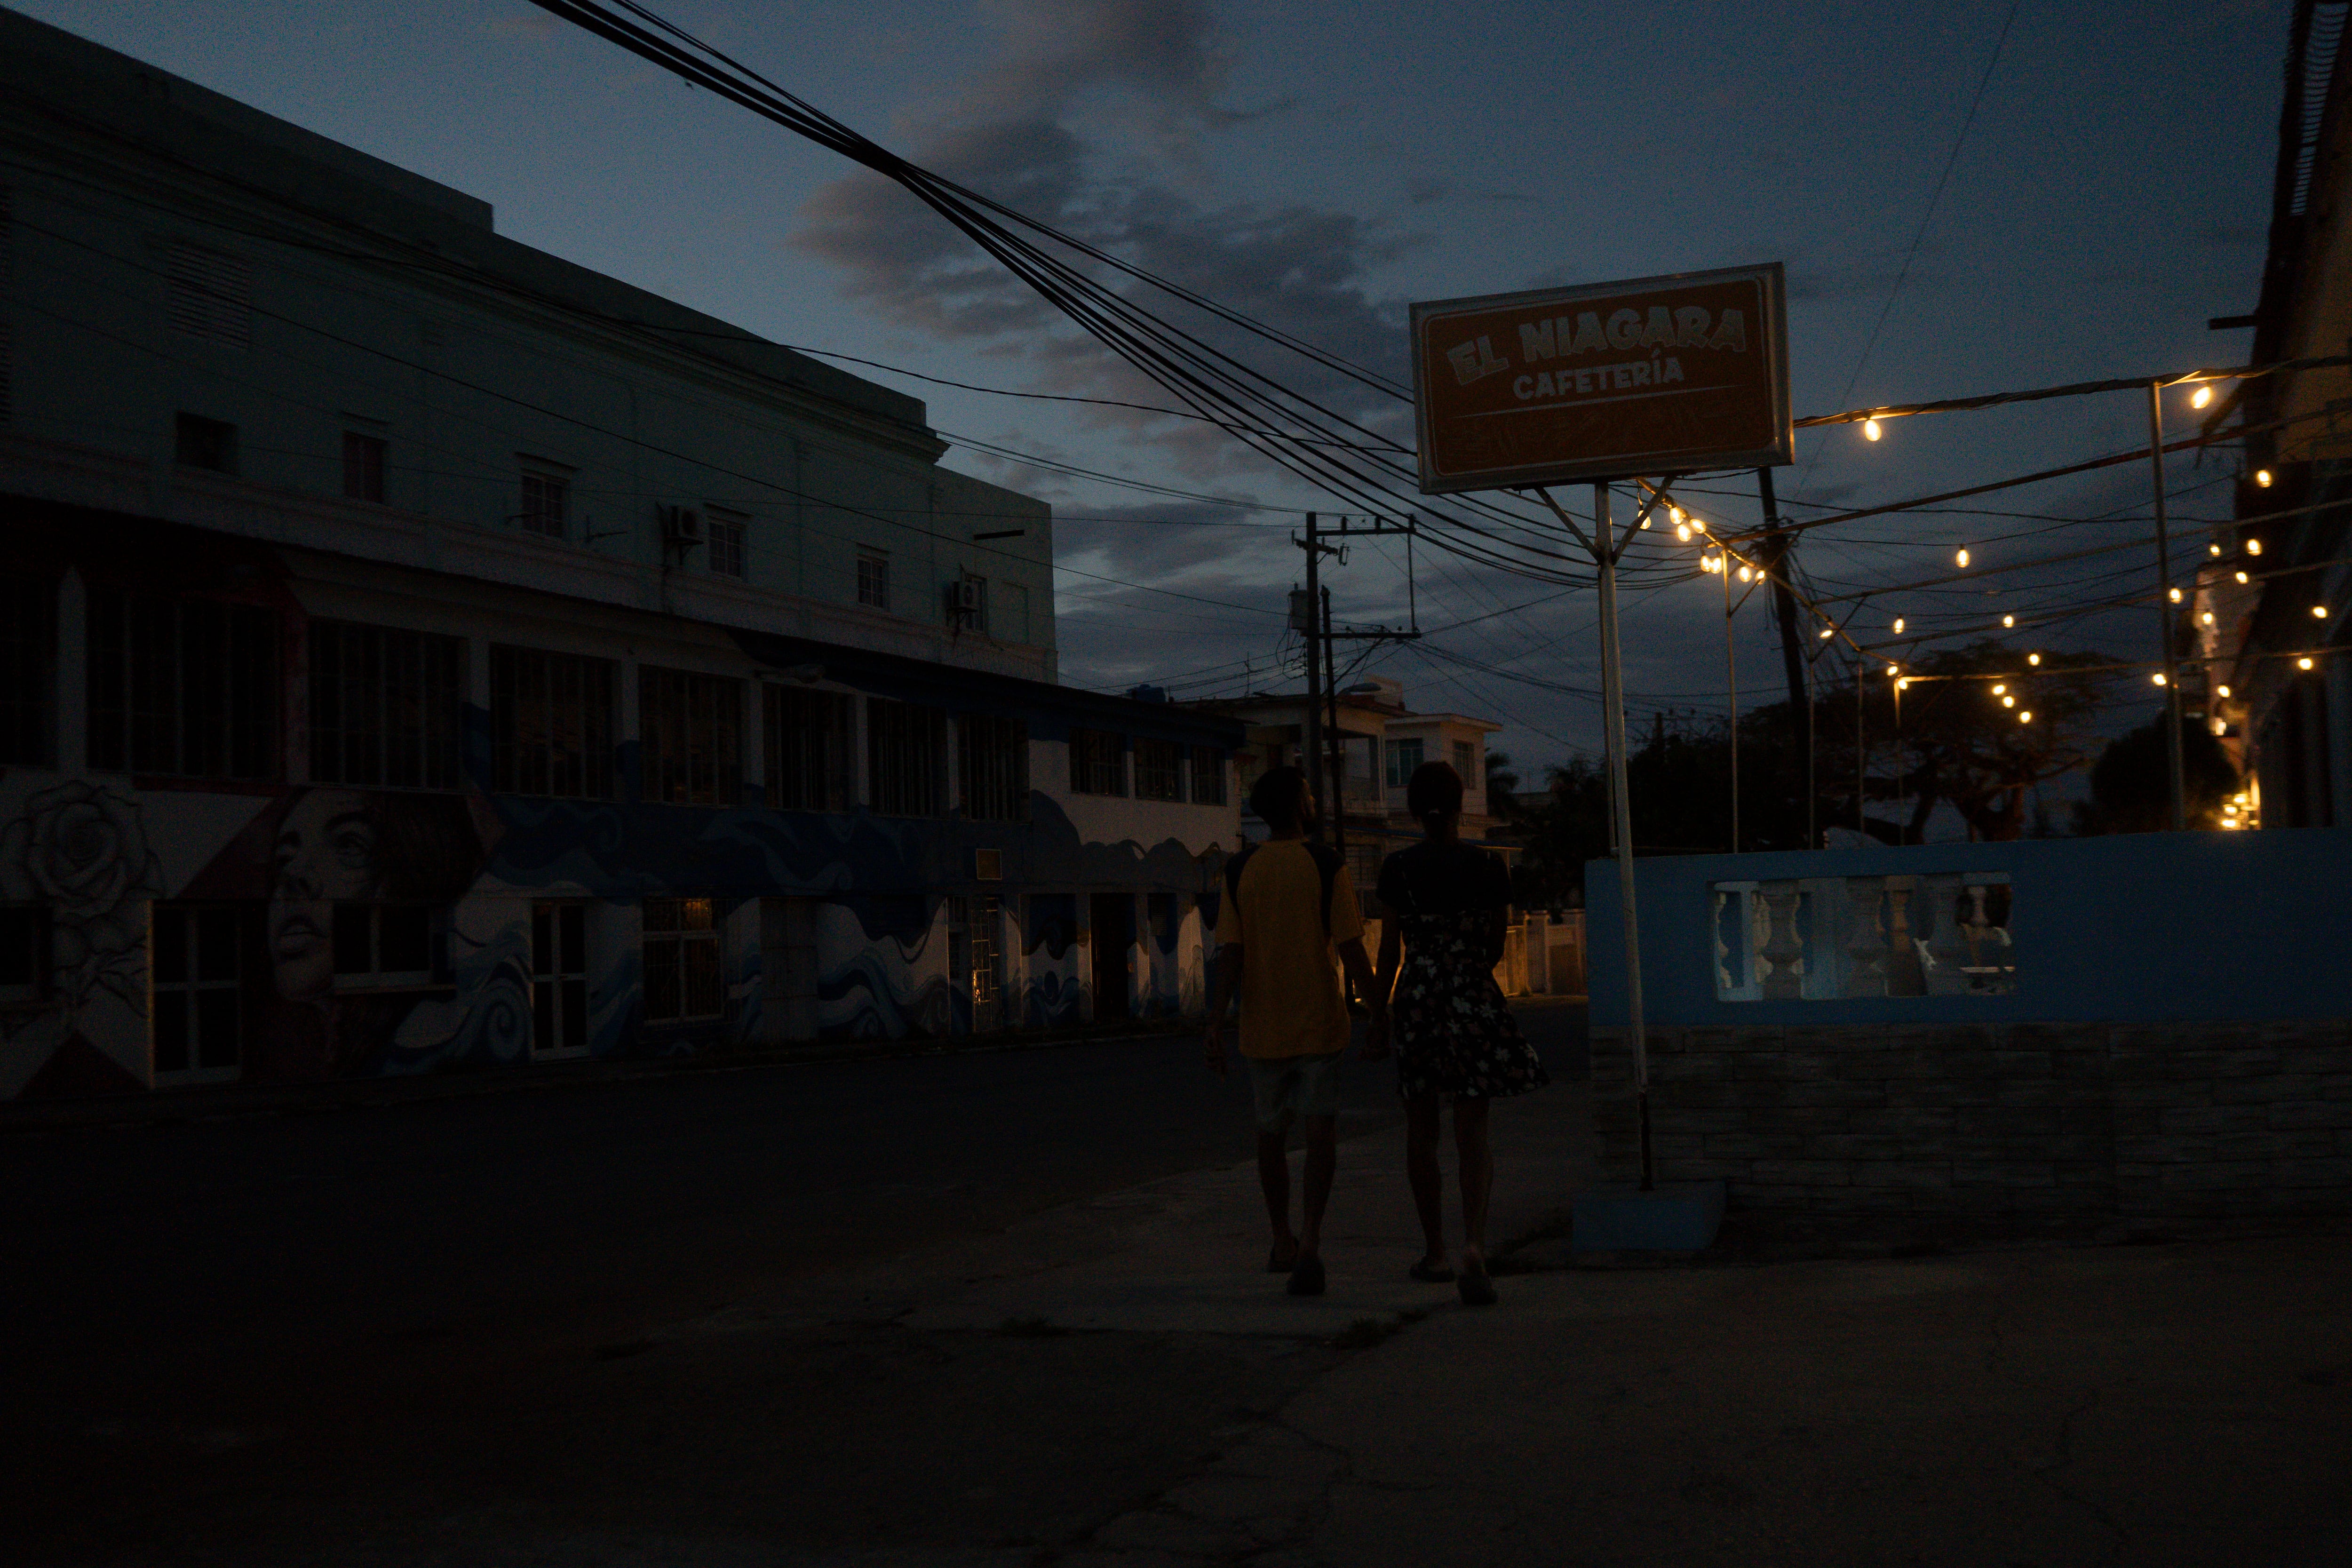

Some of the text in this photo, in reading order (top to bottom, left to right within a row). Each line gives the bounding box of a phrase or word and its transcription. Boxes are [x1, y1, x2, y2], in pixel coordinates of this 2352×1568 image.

[1446, 306, 1746, 385] EL NIAGARA
[1513, 349, 1684, 399] CAFETERÍA
